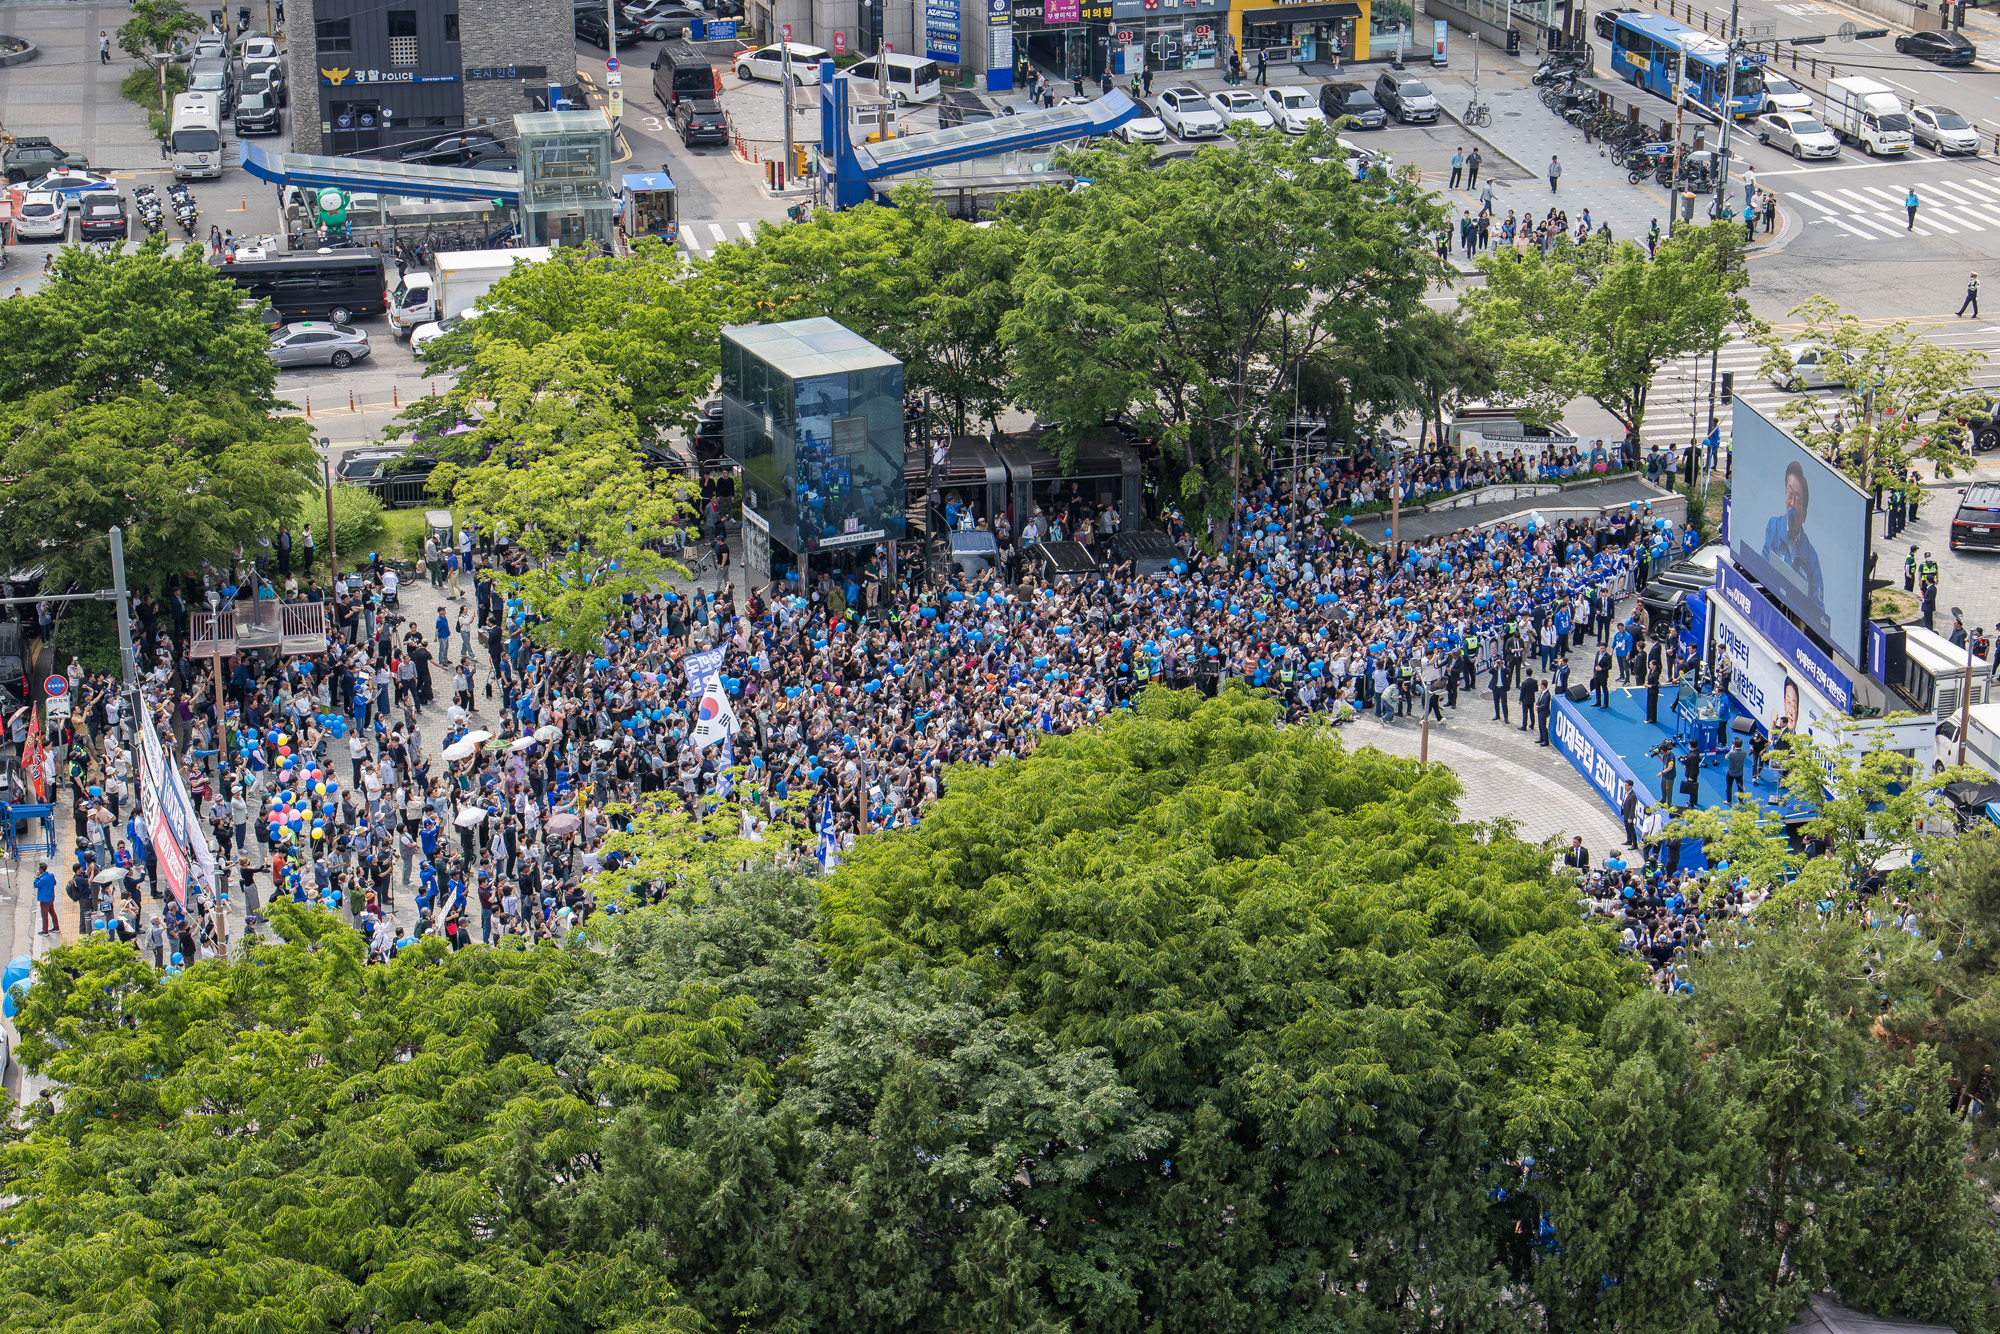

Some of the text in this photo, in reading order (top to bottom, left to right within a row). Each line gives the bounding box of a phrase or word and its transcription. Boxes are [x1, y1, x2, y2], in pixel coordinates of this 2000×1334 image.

[355, 69, 414, 82] 경찰 POLICE
[473, 67, 516, 78] 도시 인천
[1721, 567, 1751, 615] 1 이재명
[1719, 622, 1750, 669] 이제부터
[1873, 631, 1881, 673] 1
[1733, 666, 1765, 715] 대한민국
[1796, 648, 1847, 708] 이제부터 진짜 대한민국
[1555, 710, 1595, 774] 이제부터
[1595, 752, 1616, 799] 진짜
